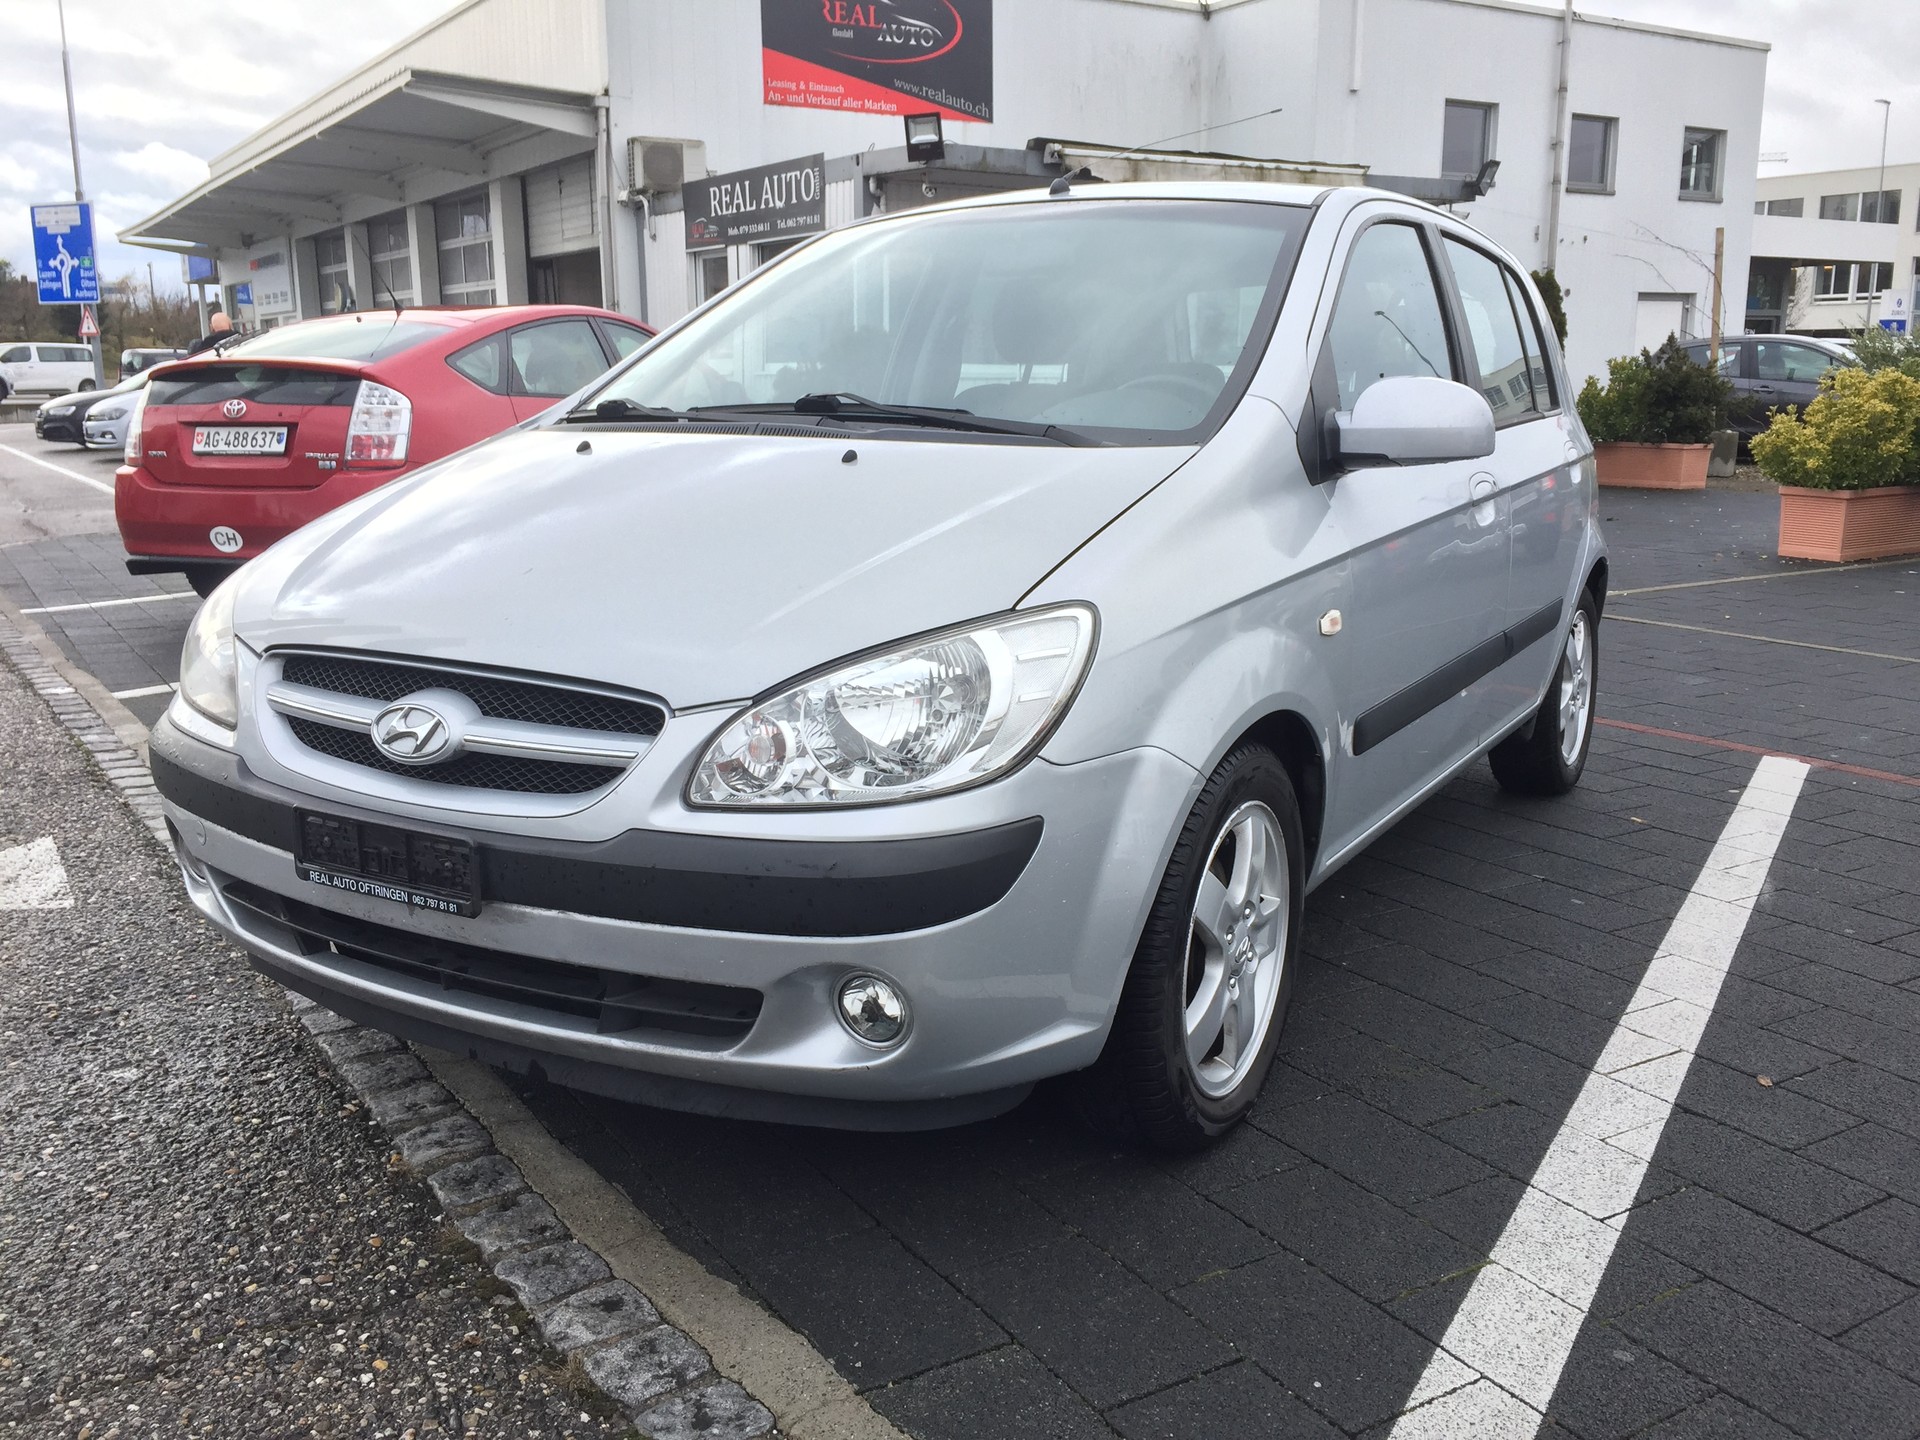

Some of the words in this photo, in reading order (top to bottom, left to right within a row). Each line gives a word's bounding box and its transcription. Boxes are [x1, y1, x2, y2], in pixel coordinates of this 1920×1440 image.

[823, 0, 882, 29] REAL
[832, 28, 854, 39] GmbH
[877, 23, 934, 47] AUTO
[767, 78, 797, 90] Leasing
[799, 81, 806, 90] &
[809, 82, 845, 93] Eintausch
[768, 90, 785, 101] An-
[787, 92, 805, 103] und
[806, 93, 842, 107] Verkauf
[843, 98, 862, 109] aller
[864, 99, 898, 112] Marken
[894, 78, 990, 118] www.realauto.ch
[709, 180, 757, 217] REAL
[760, 168, 815, 209] AUTO
[214, 531, 239, 546] CH
[309, 870, 331, 886] REAL
[333, 876, 357, 891] AUTO
[358, 881, 408, 903] OFTRINGEN
[412, 894, 425, 906] 062
[426, 897, 438, 908] 797
[439, 900, 448, 911] 81
[449, 902, 458, 913] 81
